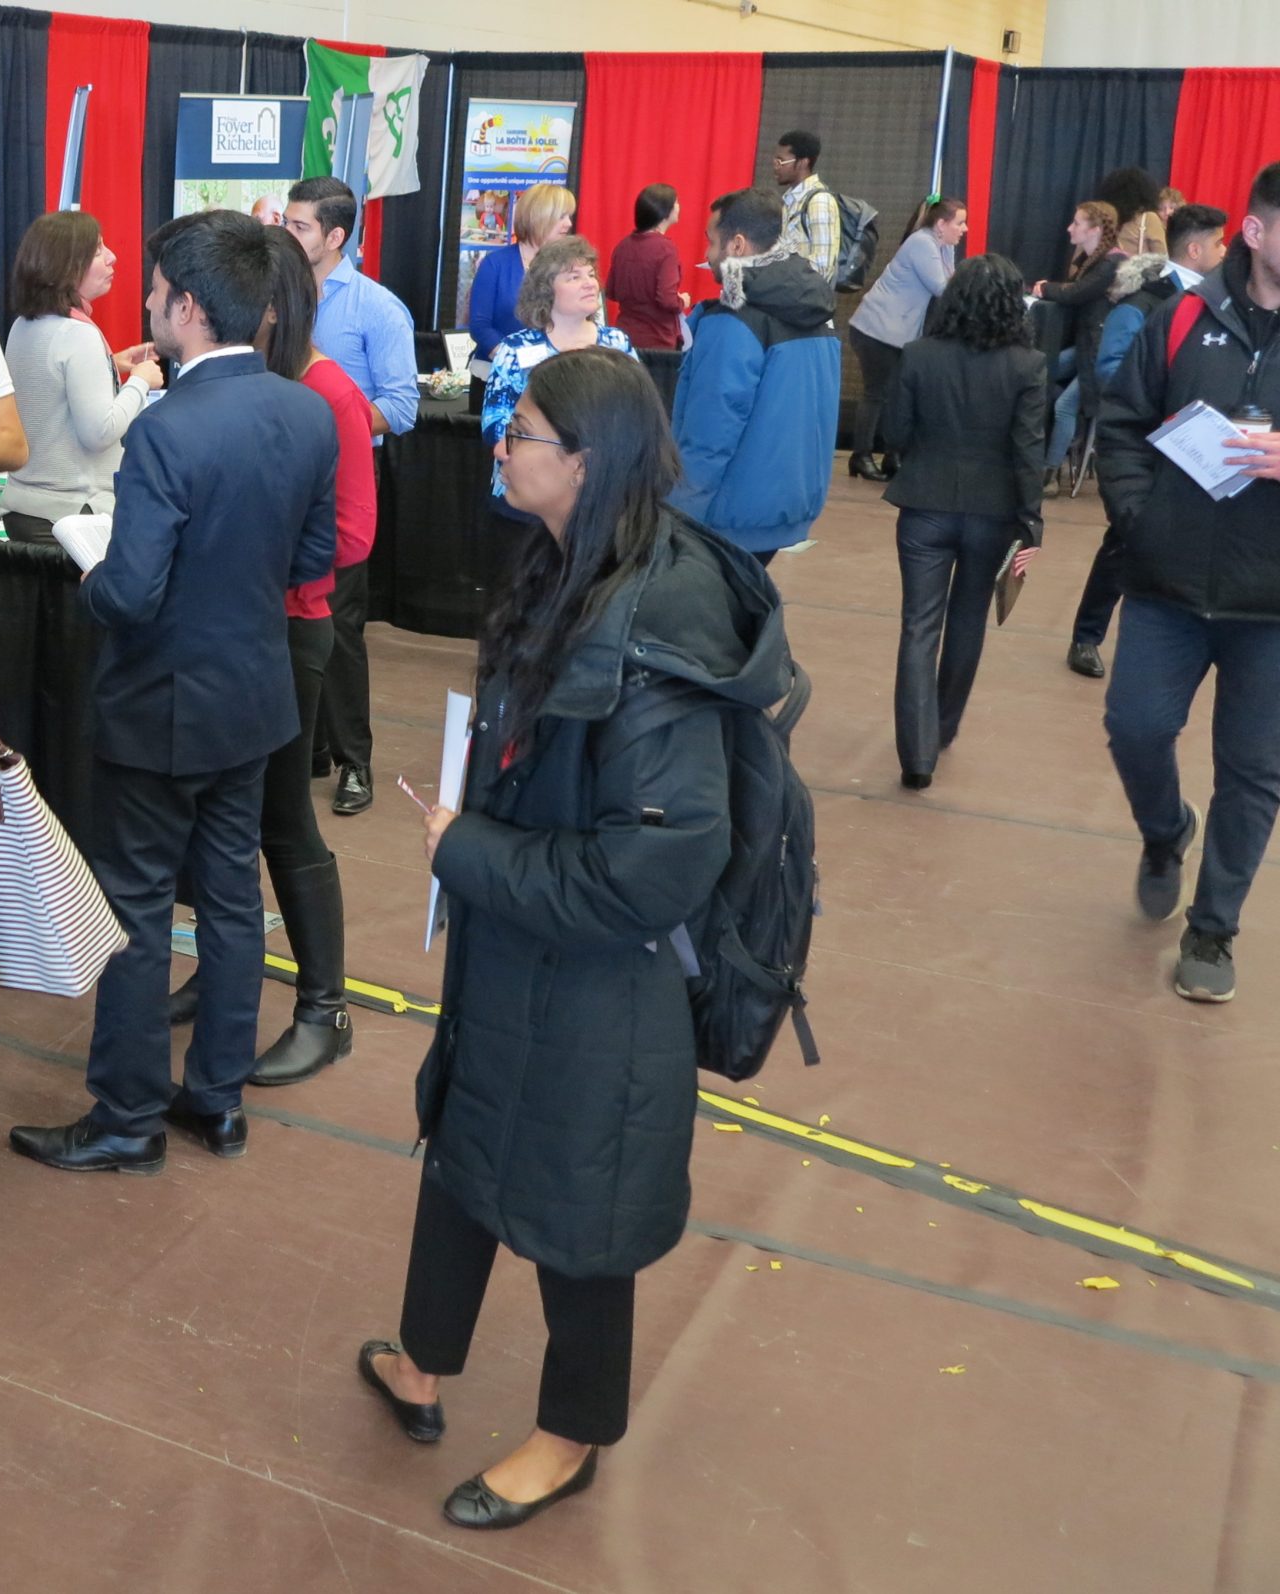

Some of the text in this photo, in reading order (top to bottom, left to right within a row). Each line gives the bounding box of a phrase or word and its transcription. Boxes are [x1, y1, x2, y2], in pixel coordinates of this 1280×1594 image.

[217, 116, 254, 137] Foyer
[216, 134, 276, 151] Richelieu
[495, 136, 505, 145] LA
[535, 137, 559, 146] SOLEIL
[480, 176, 508, 185] opportunité
[508, 177, 525, 186] unique
